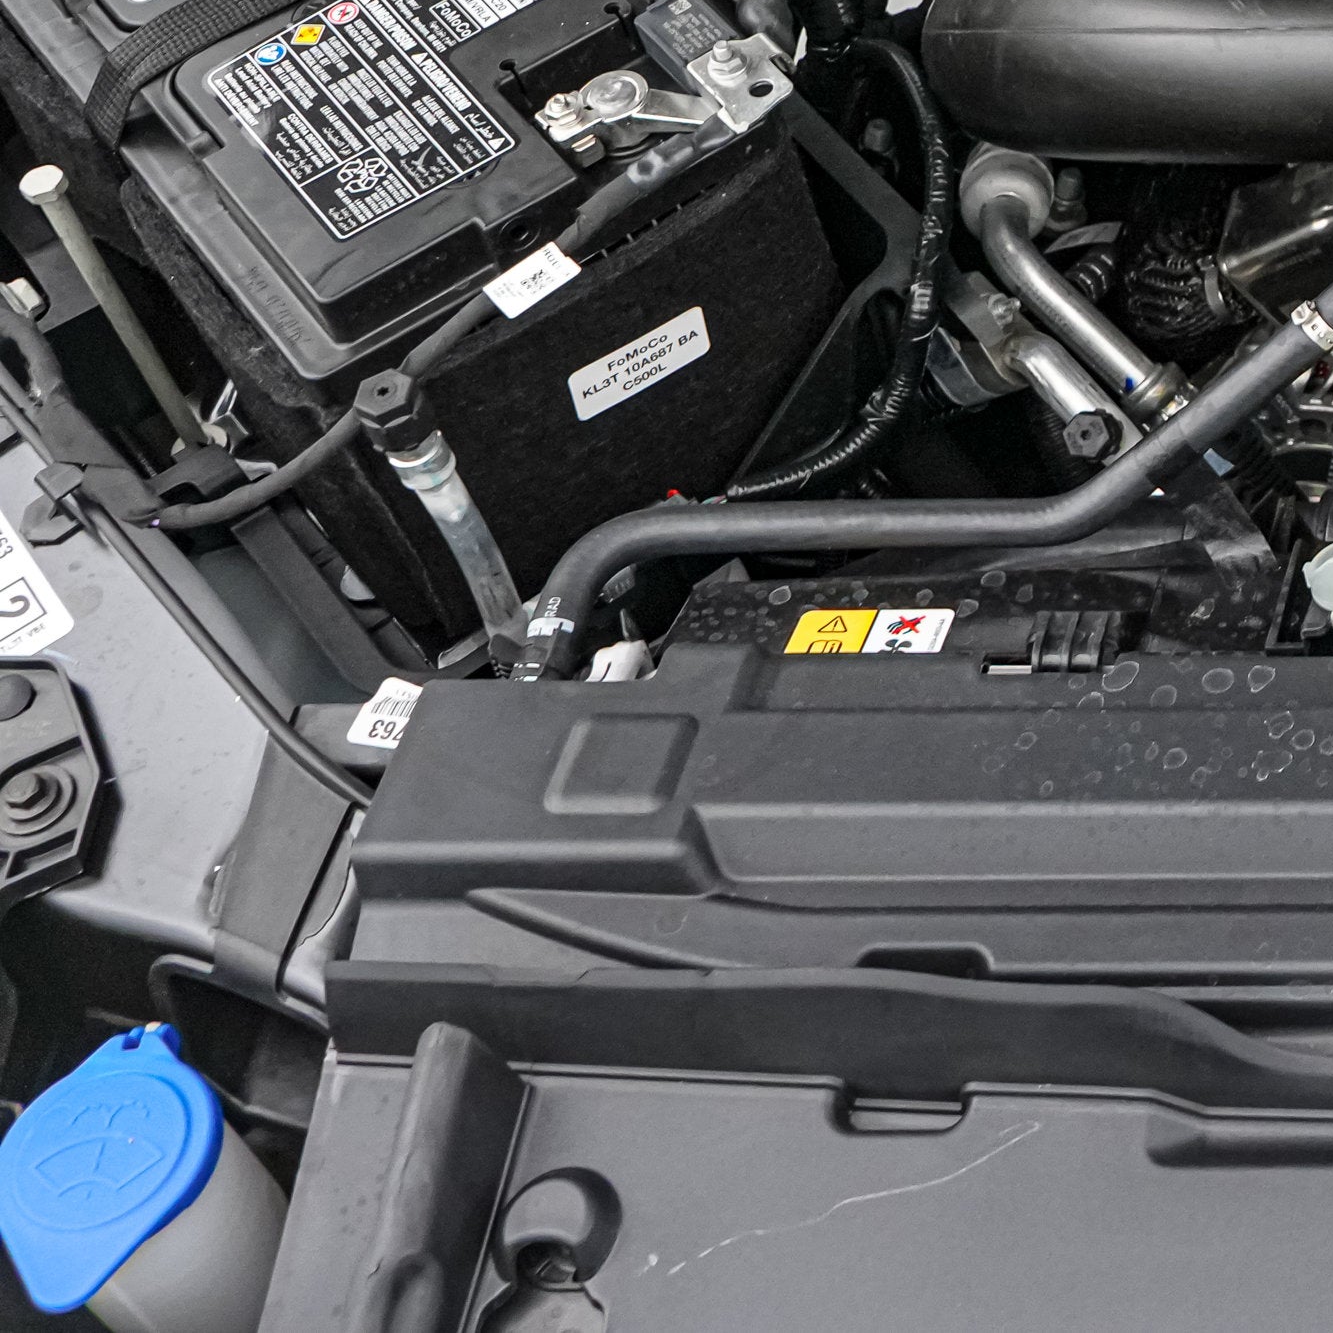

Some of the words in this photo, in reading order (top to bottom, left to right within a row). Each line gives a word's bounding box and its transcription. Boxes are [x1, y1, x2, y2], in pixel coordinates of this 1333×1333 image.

[437, 1, 473, 38] FoMoCo
[417, 57, 473, 111] PELIGRO/VENENO
[582, 372, 620, 400] KL3T
[624, 342, 674, 376] 10A687
[677, 329, 699, 347] BA
[607, 334, 668, 372] FoMoCo
[622, 363, 668, 392] C500L
[544, 596, 562, 617] RAD
